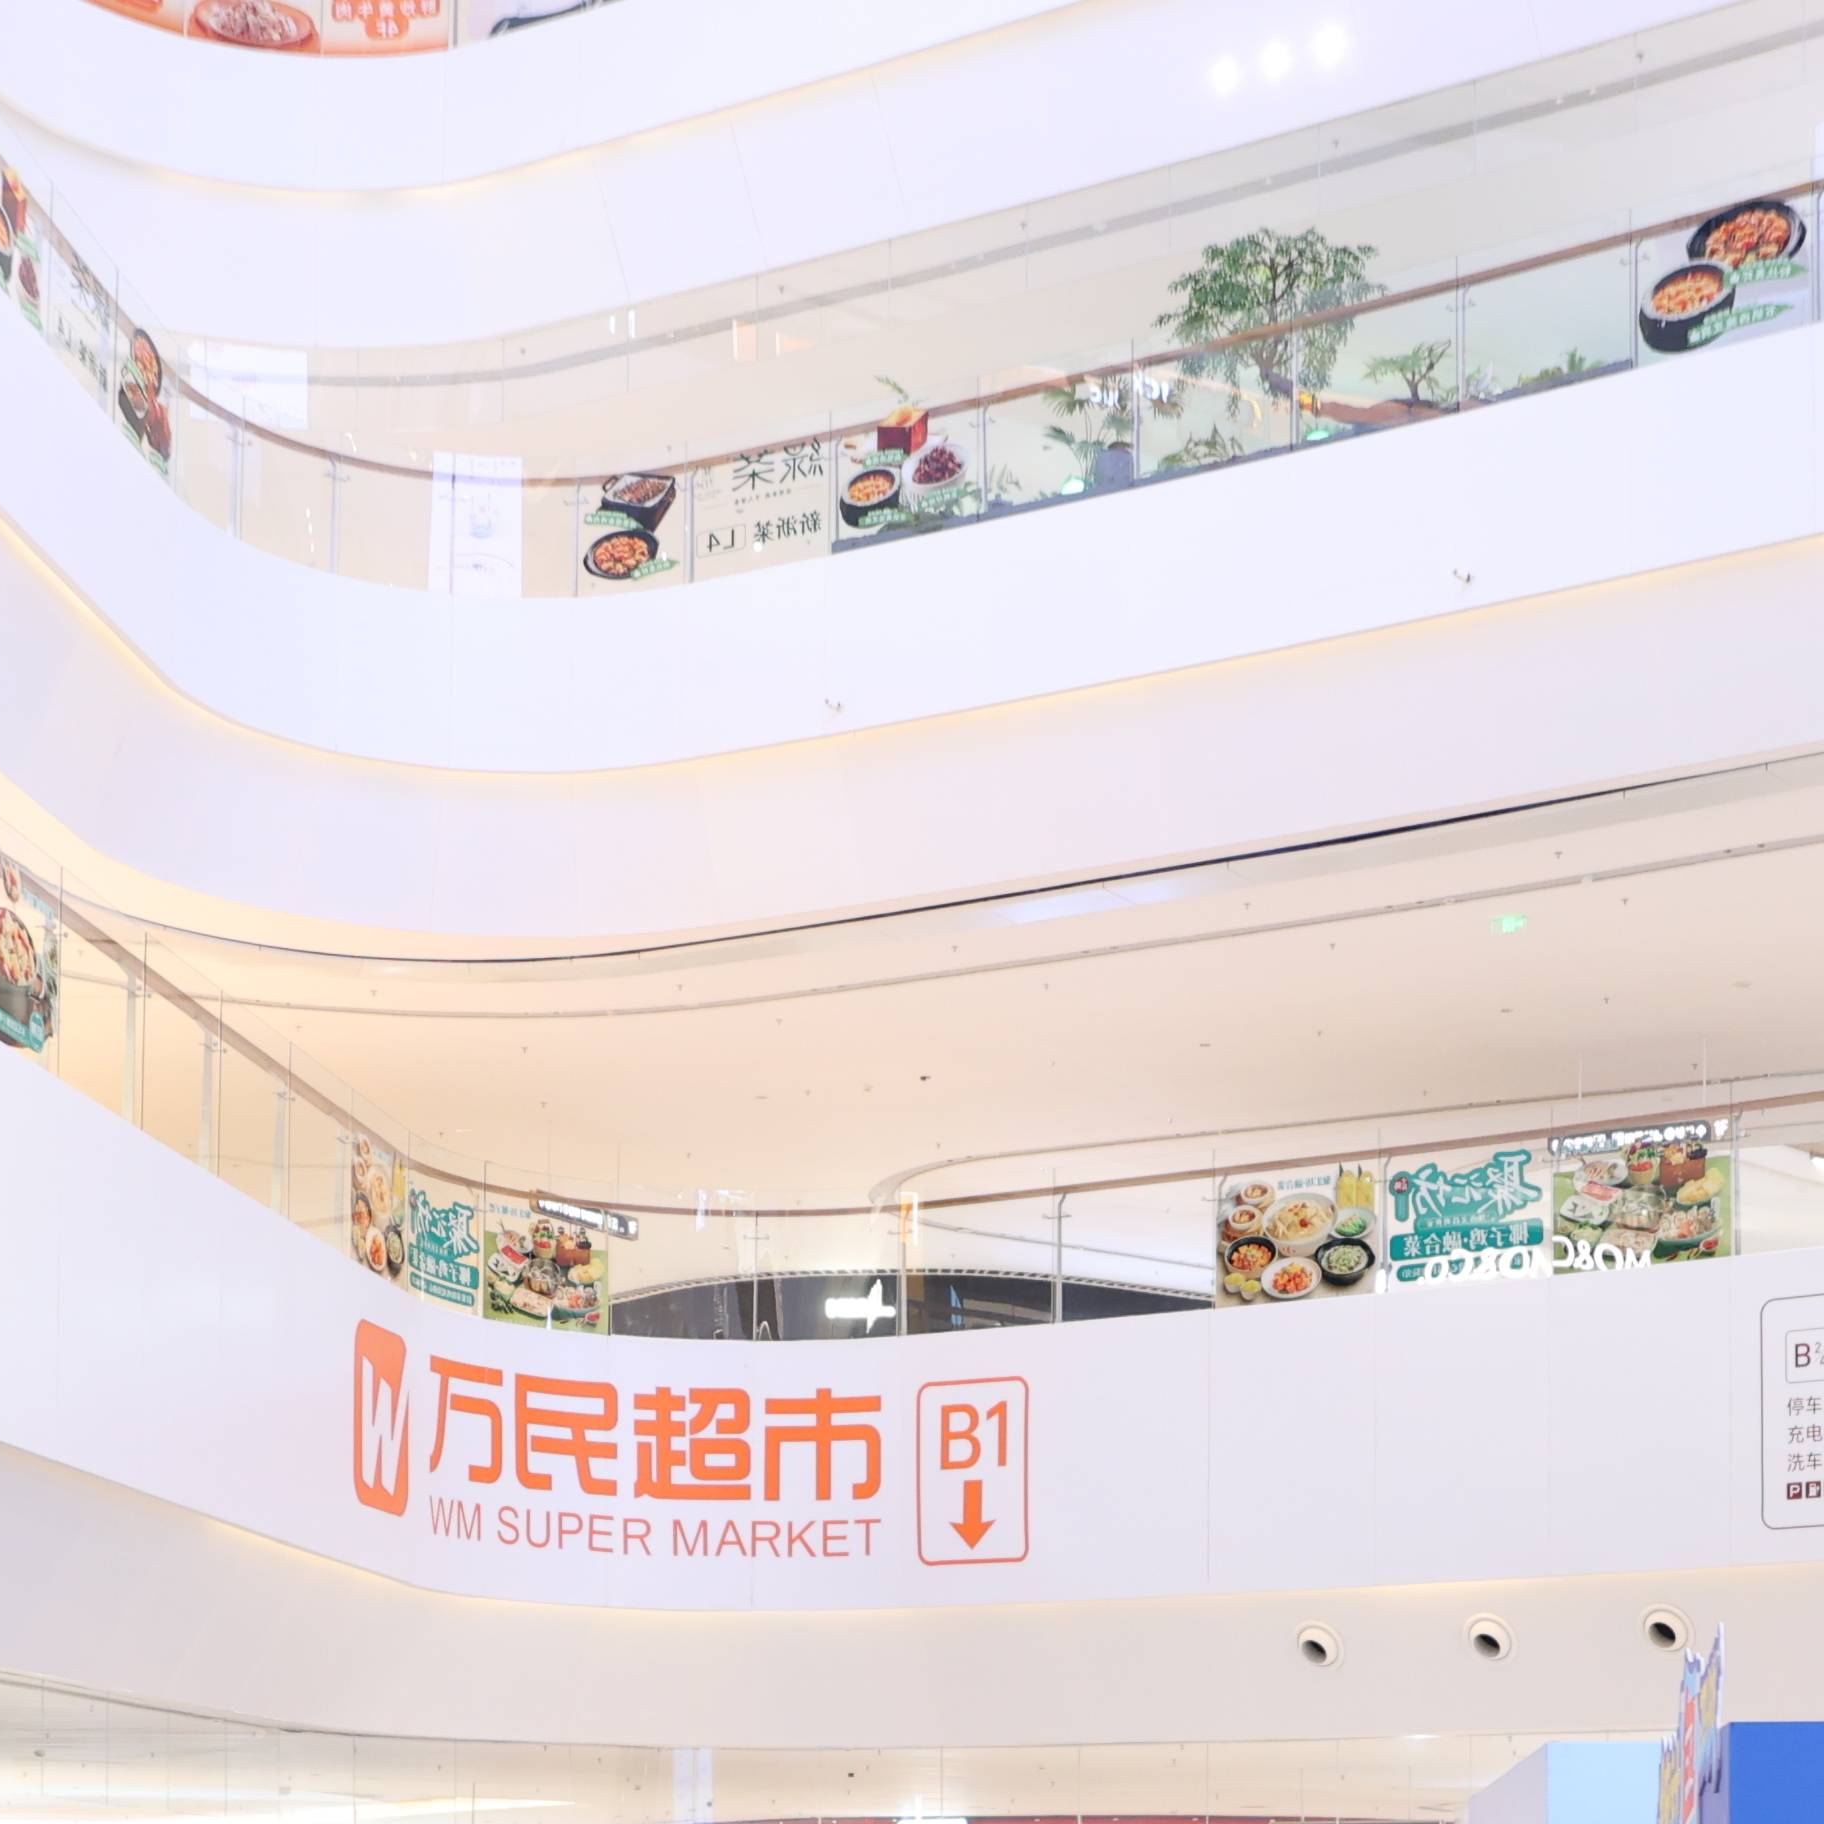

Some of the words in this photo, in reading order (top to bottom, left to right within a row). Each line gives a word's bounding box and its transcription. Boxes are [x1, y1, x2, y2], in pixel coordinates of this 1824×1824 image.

[429, 1354, 882, 1501] 万民超市
[940, 1400, 1008, 1470] B1
[429, 1494, 482, 1543] WM
[497, 1505, 652, 1557] SUPER
[673, 1517, 882, 1558] MARKET
